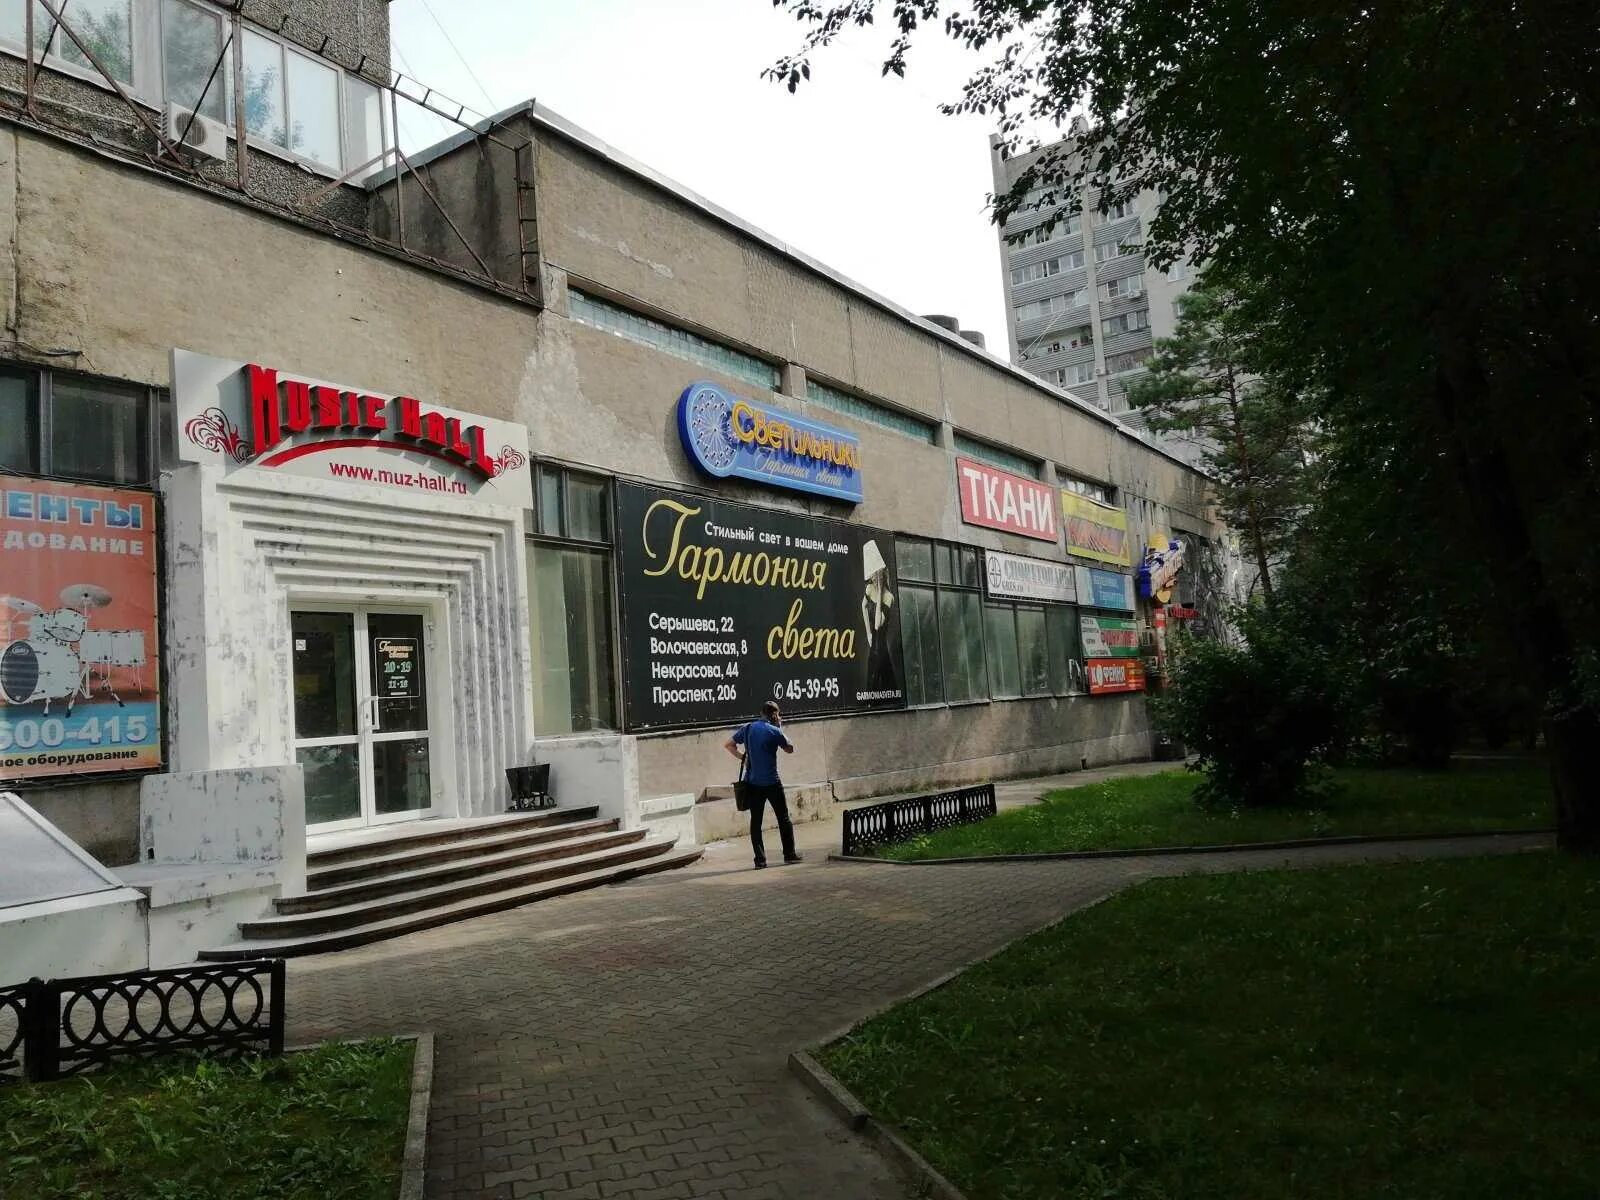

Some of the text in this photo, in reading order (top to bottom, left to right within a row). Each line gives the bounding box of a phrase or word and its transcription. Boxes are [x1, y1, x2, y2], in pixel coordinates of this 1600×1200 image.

[329, 462, 468, 495] www.muz-hall.ru
[0, 490, 143, 531] ЕНТЫ
[962, 469, 1054, 535] ТКАНИ
[643, 499, 827, 600] Гармония
[704, 521, 849, 555] Стильный свет в вашем доме
[649, 612, 735, 634] Серышева, 22
[767, 598, 856, 660] света
[650, 637, 748, 657] Волочаевская, 8
[651, 661, 739, 682] Некрасова, 44
[653, 684, 737, 707] Проспект, 206
[786, 678, 839, 700] 45-39-95
[27, 751, 138, 767] оборудование
